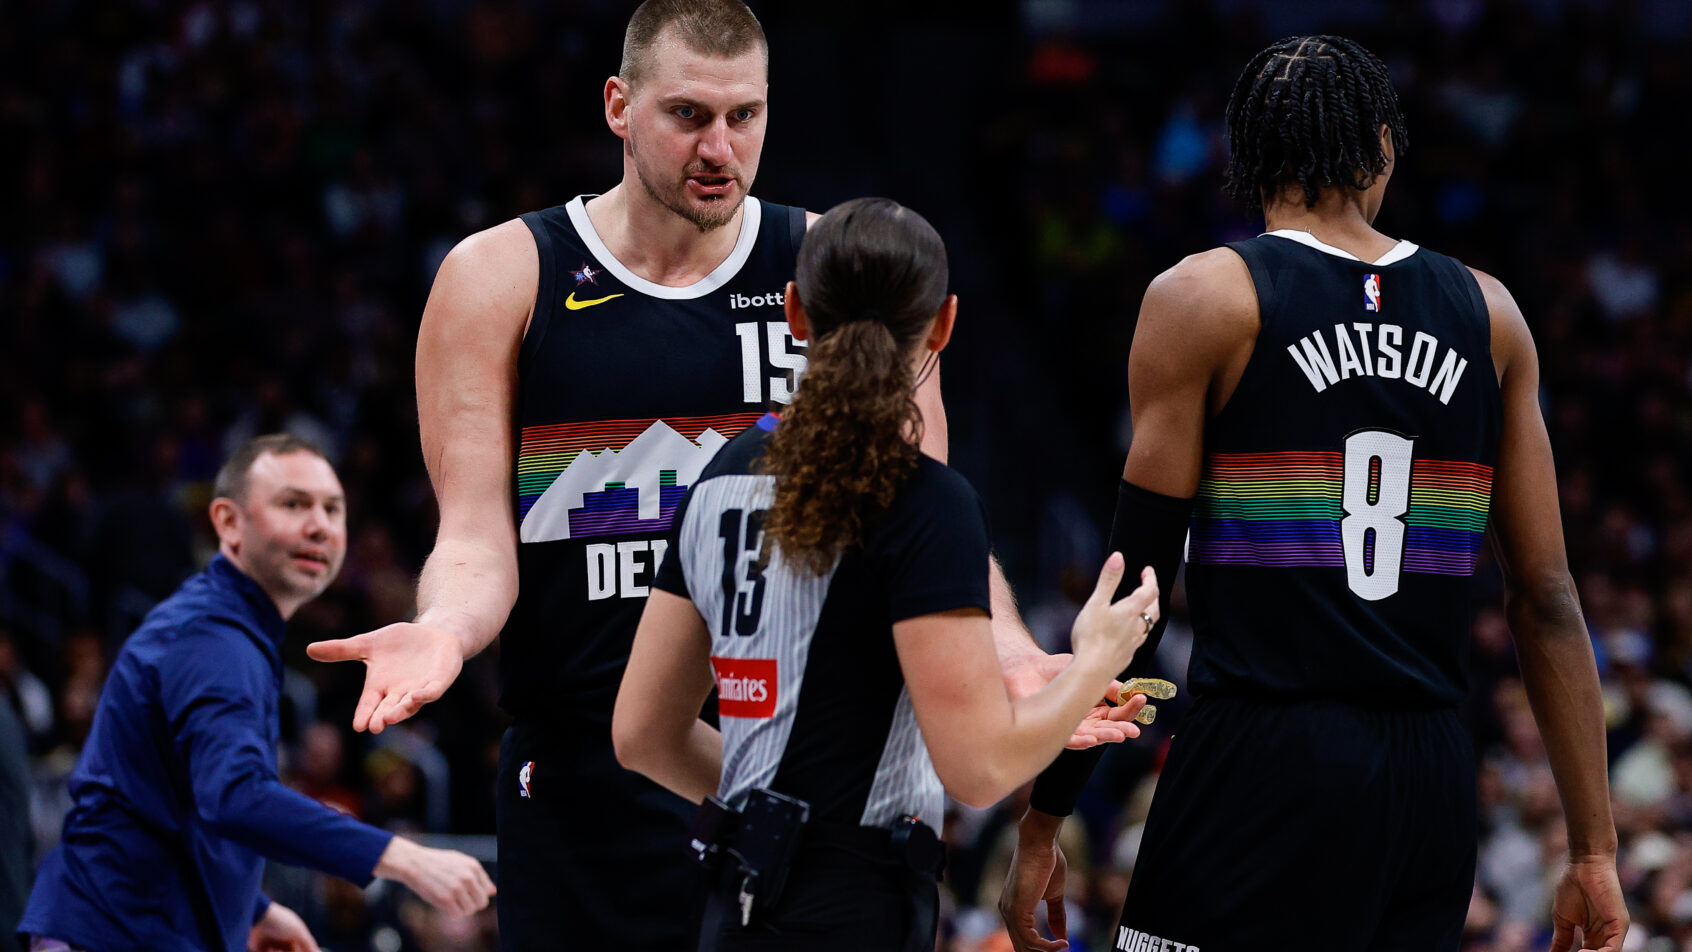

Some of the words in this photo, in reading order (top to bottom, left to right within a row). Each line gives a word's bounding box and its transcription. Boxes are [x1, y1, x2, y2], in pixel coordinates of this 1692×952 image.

[730, 292, 787, 309] ibott
[735, 321, 809, 405] 15
[1287, 322, 1468, 406] WATSON
[1341, 428, 1414, 601] 8
[718, 508, 771, 637] 13
[717, 671, 768, 702] mirates
